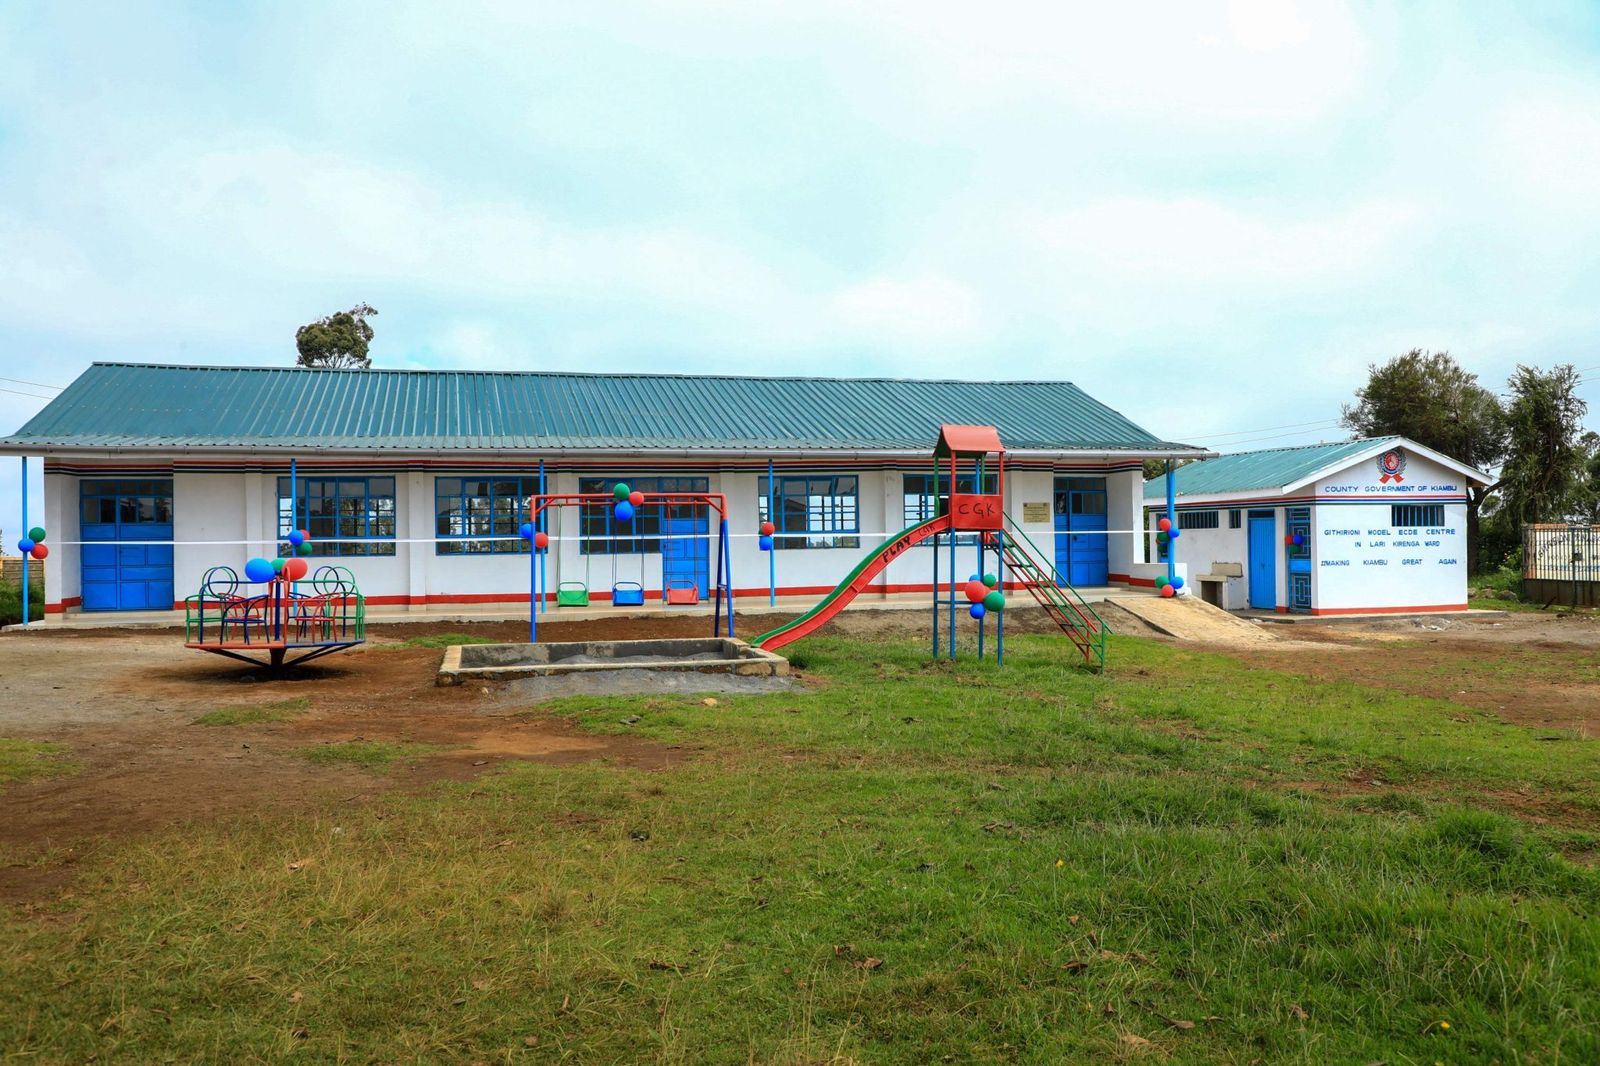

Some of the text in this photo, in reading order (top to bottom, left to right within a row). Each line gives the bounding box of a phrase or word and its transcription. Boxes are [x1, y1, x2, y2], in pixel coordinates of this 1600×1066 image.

[1324, 485, 1359, 493] COUNTY
[1364, 485, 1415, 493] GOVERNMENT
[958, 502, 995, 519] CGK
[882, 534, 911, 564] PLAY
